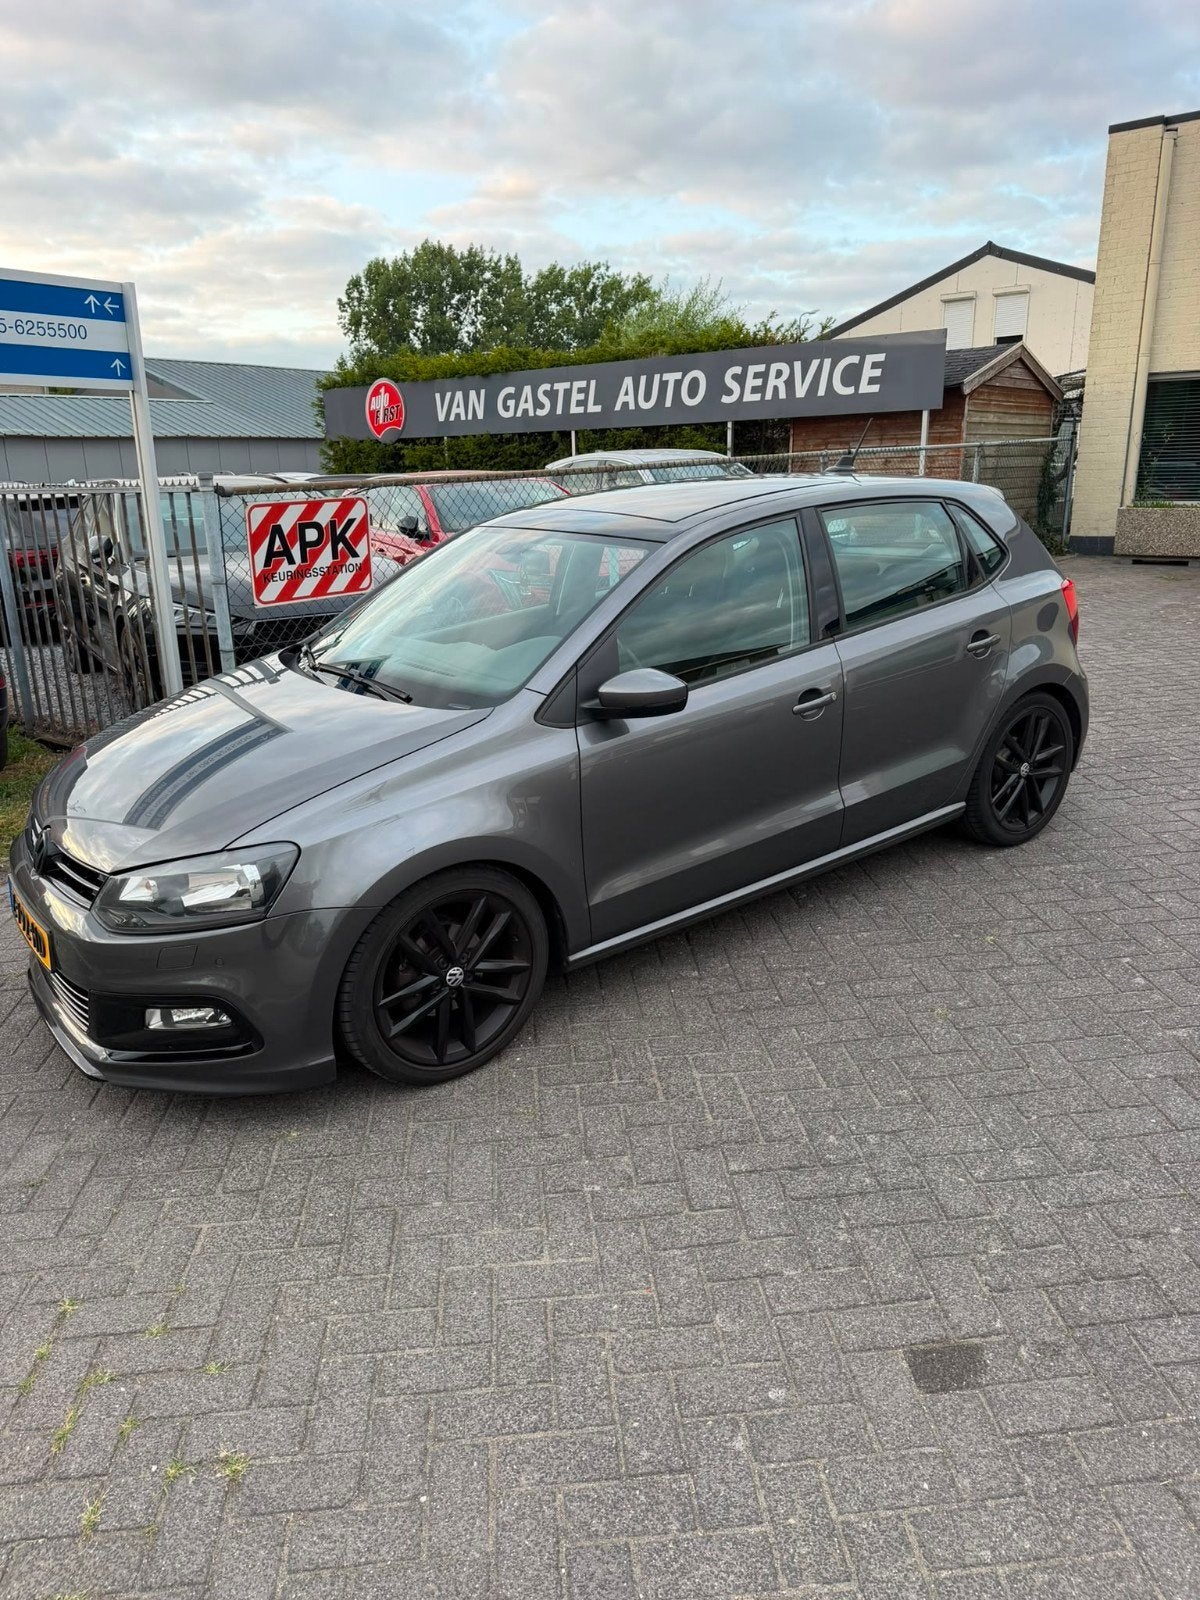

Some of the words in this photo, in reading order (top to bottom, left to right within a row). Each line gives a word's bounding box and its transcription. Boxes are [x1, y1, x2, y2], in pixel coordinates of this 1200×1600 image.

[434, 388, 486, 422] VAN
[496, 381, 602, 419] GASTEL
[613, 370, 707, 412] AUTO
[720, 352, 887, 404] SERVICE
[263, 517, 360, 569] APK
[263, 562, 362, 583] KEURINGSSTATION
